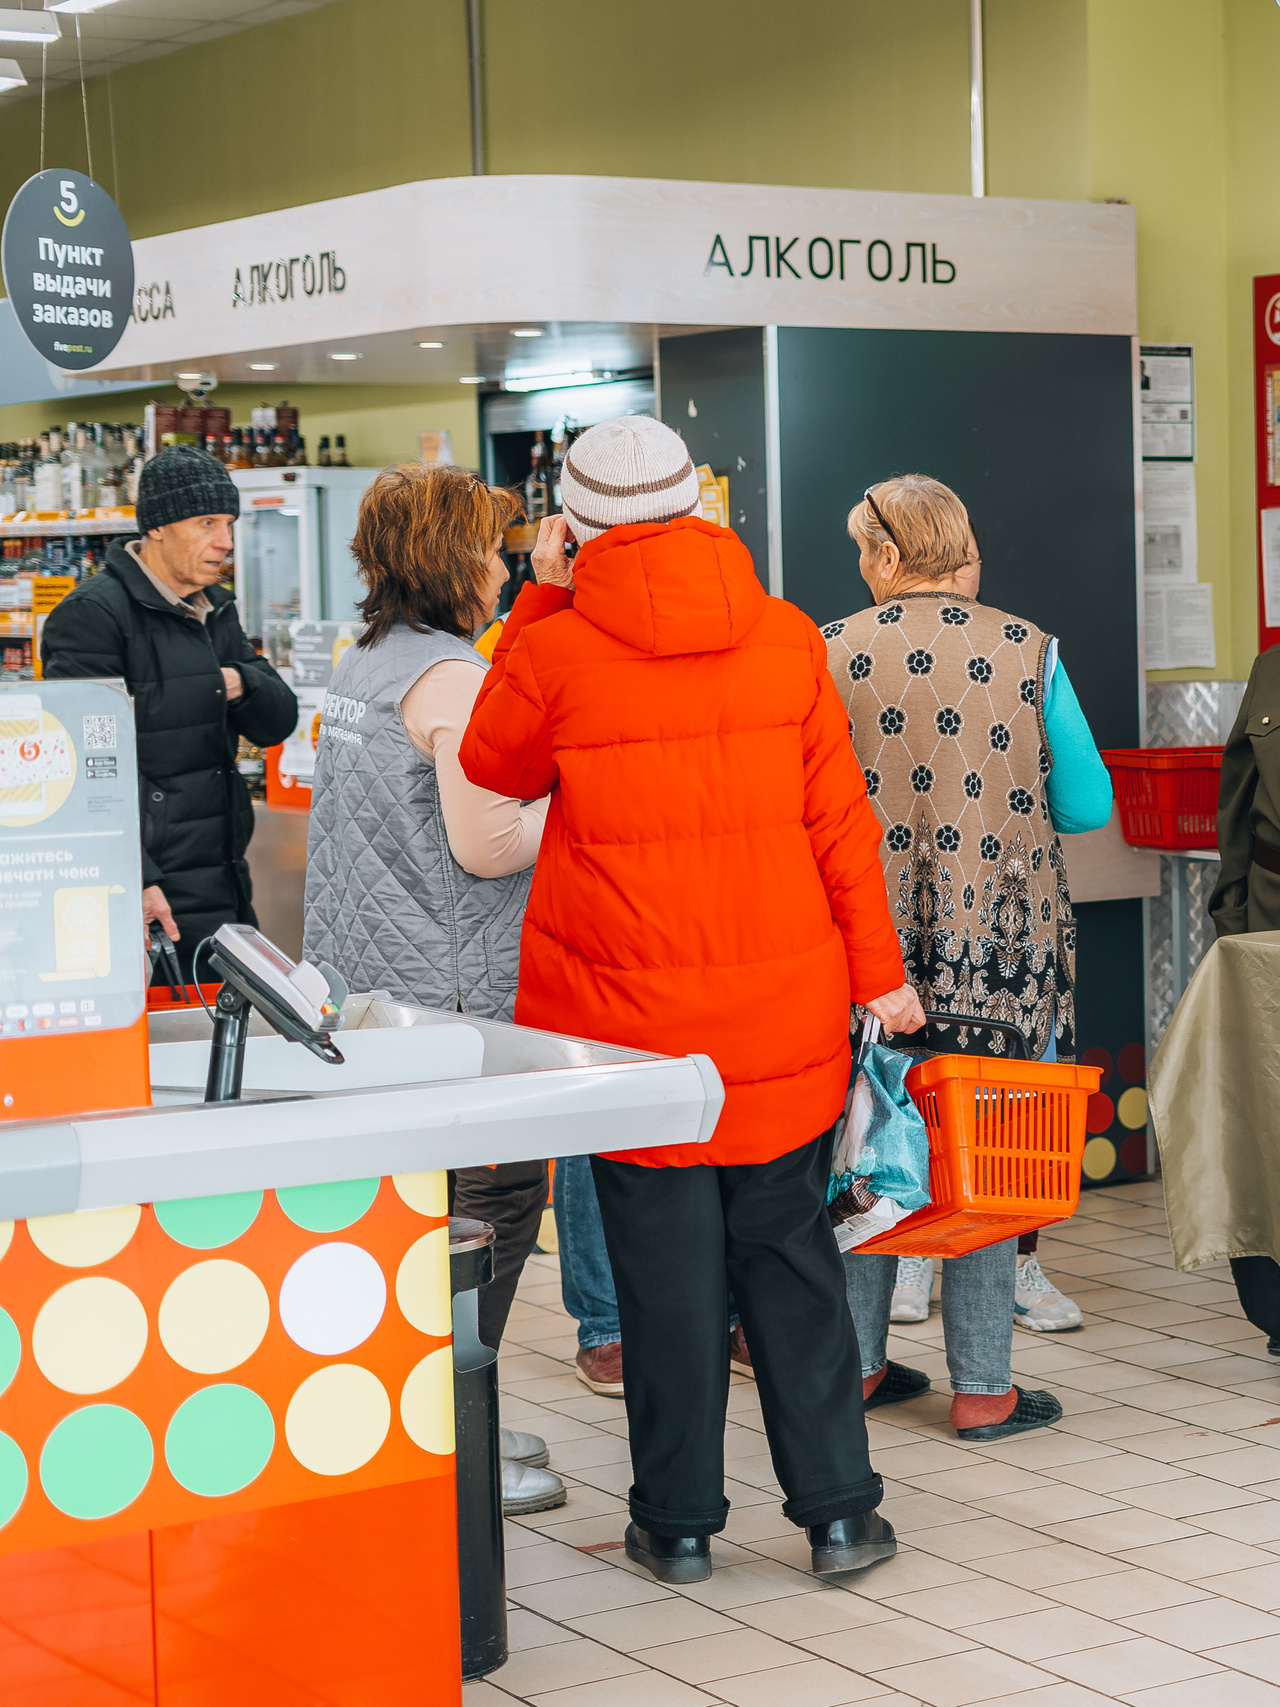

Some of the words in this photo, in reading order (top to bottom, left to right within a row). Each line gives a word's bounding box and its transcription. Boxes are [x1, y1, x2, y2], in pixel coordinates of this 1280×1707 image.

[38, 237, 105, 269] Пункт
[703, 233, 957, 284] АЛКОГОЛЬ
[32, 272, 112, 299] выдачи
[232, 250, 347, 308] АЛКОГОЛЬ
[130, 280, 176, 324] ССА
[32, 303, 114, 329] заказов
[53, 341, 93, 354] fivepost.ru
[328, 725, 363, 745] магазина
[58, 866, 100, 880] чека
